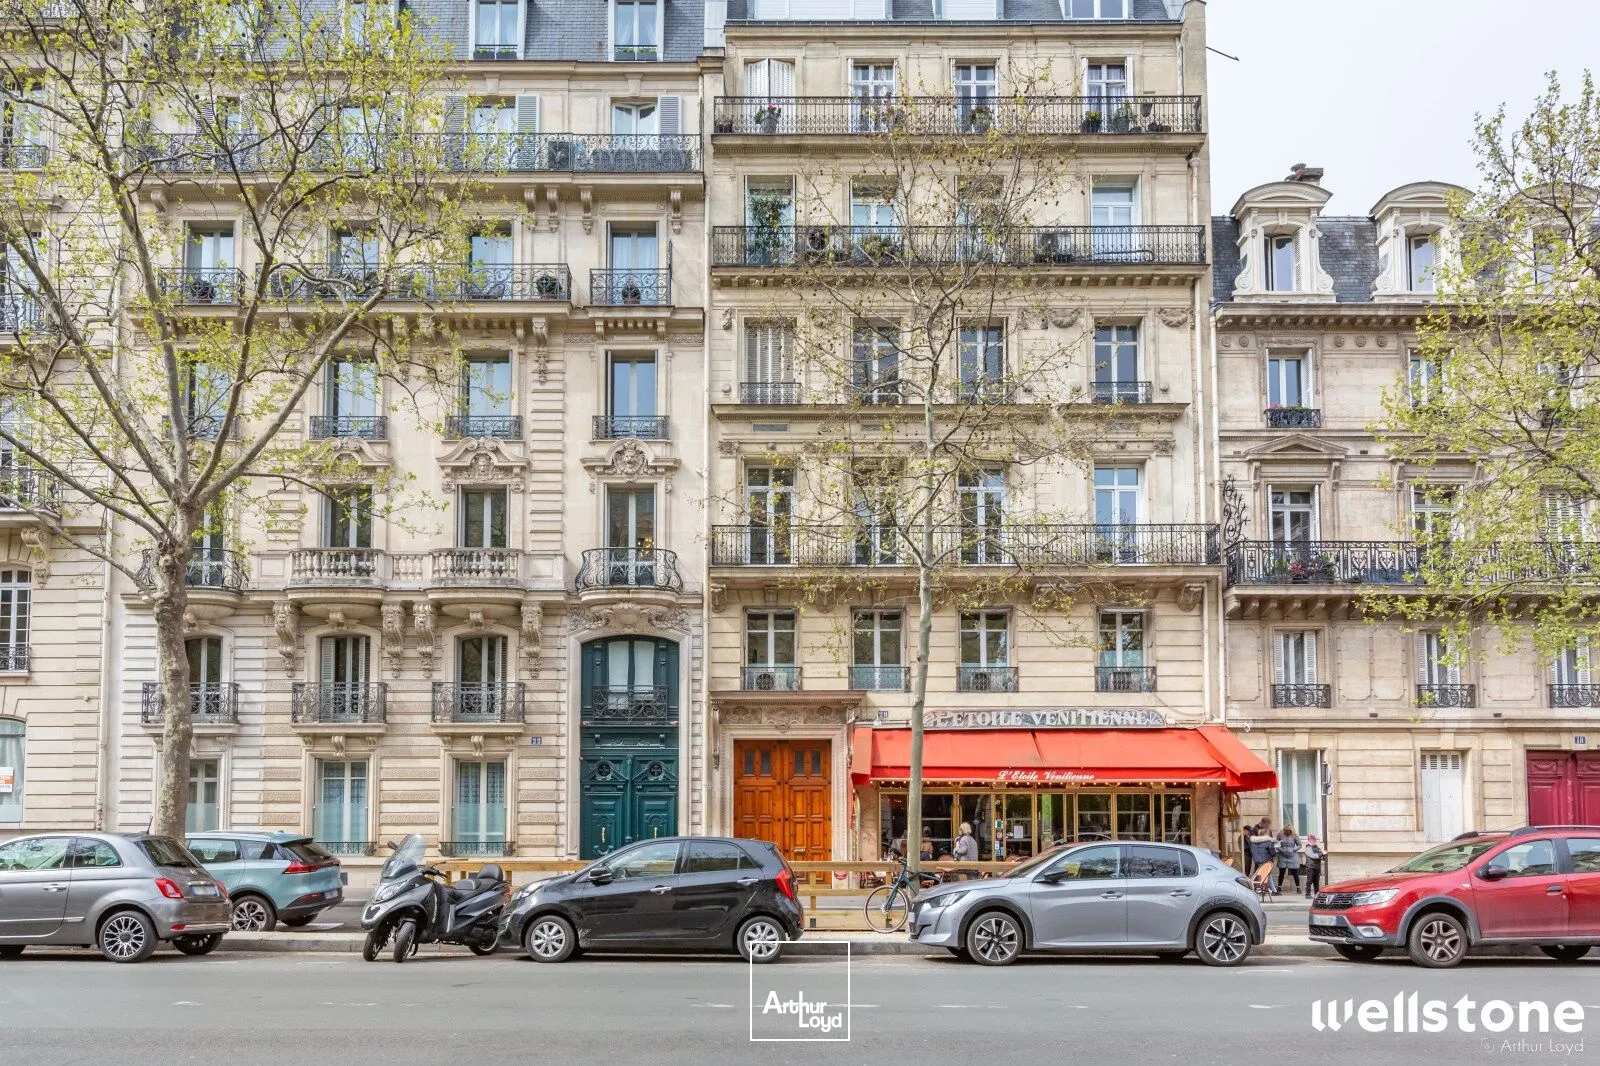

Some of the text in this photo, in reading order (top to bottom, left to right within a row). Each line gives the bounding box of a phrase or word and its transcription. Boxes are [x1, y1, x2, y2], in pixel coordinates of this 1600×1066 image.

[1029, 709, 1148, 726] VENITIENNE
[532, 737, 541, 745] 22
[1576, 736, 1585, 744] 18
